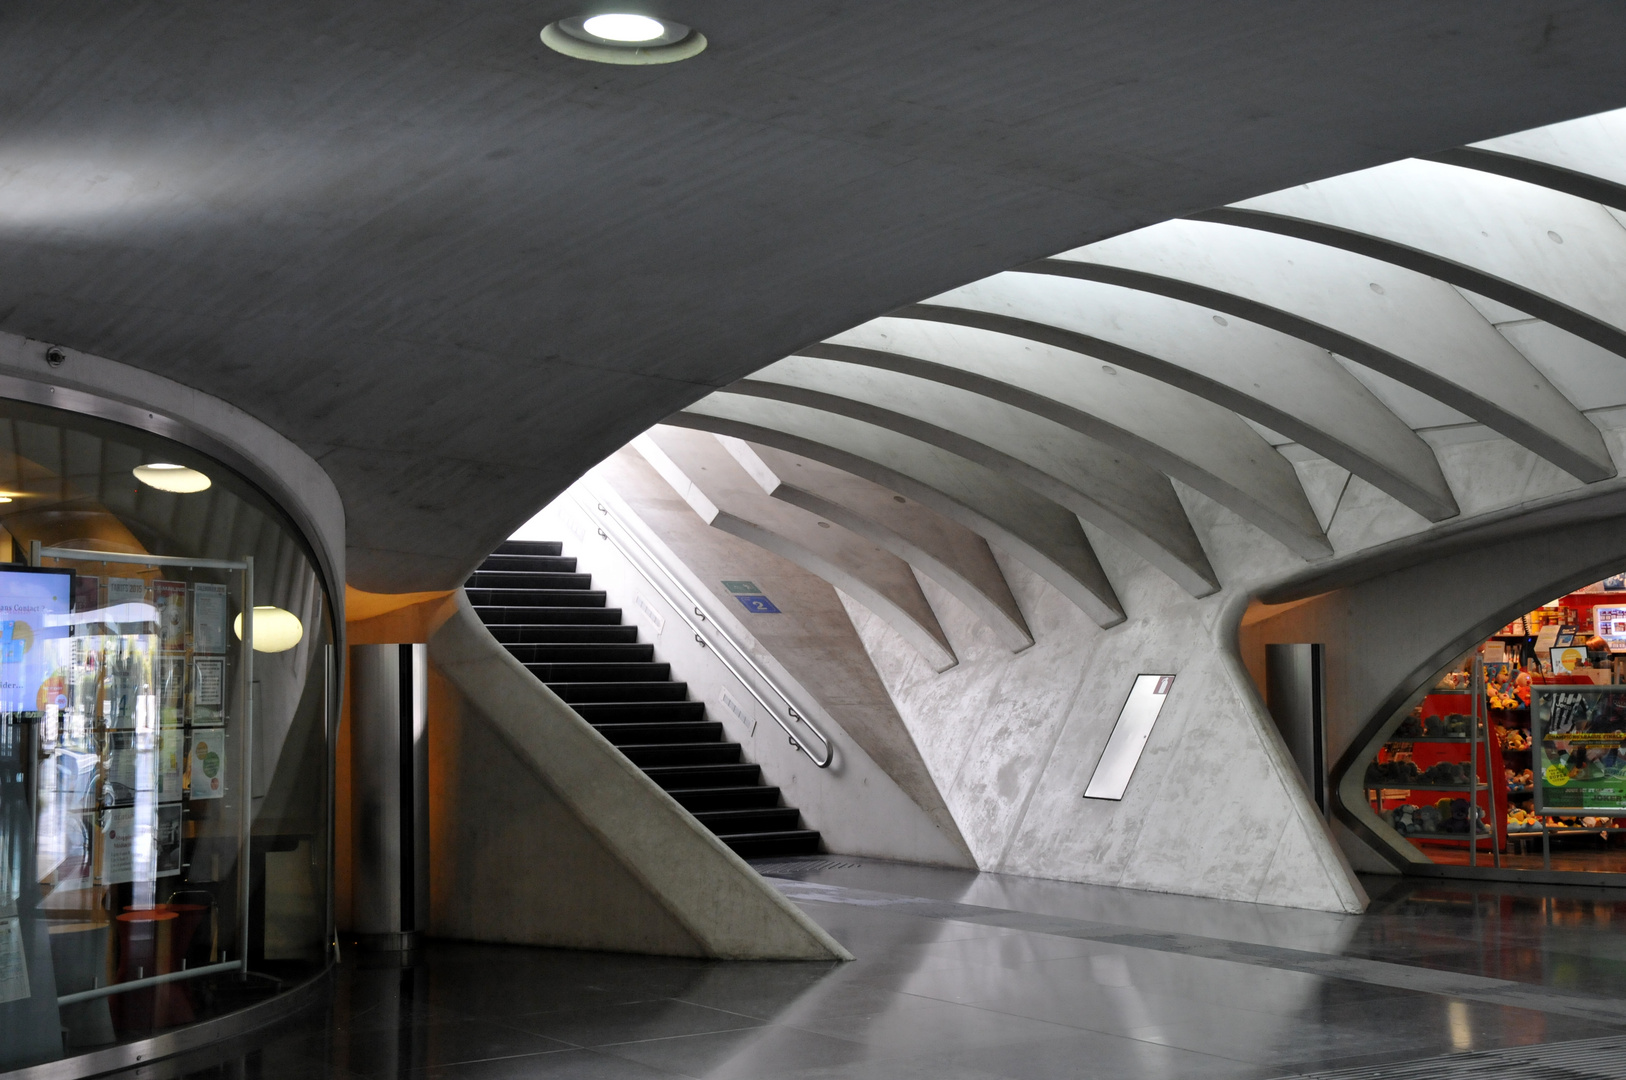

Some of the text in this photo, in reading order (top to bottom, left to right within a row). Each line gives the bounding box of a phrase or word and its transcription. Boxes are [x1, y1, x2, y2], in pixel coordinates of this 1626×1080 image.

[111, 583, 143, 593] TARIFS 2015
[13, 604, 39, 612] Contact
[752, 601, 768, 610] 2
